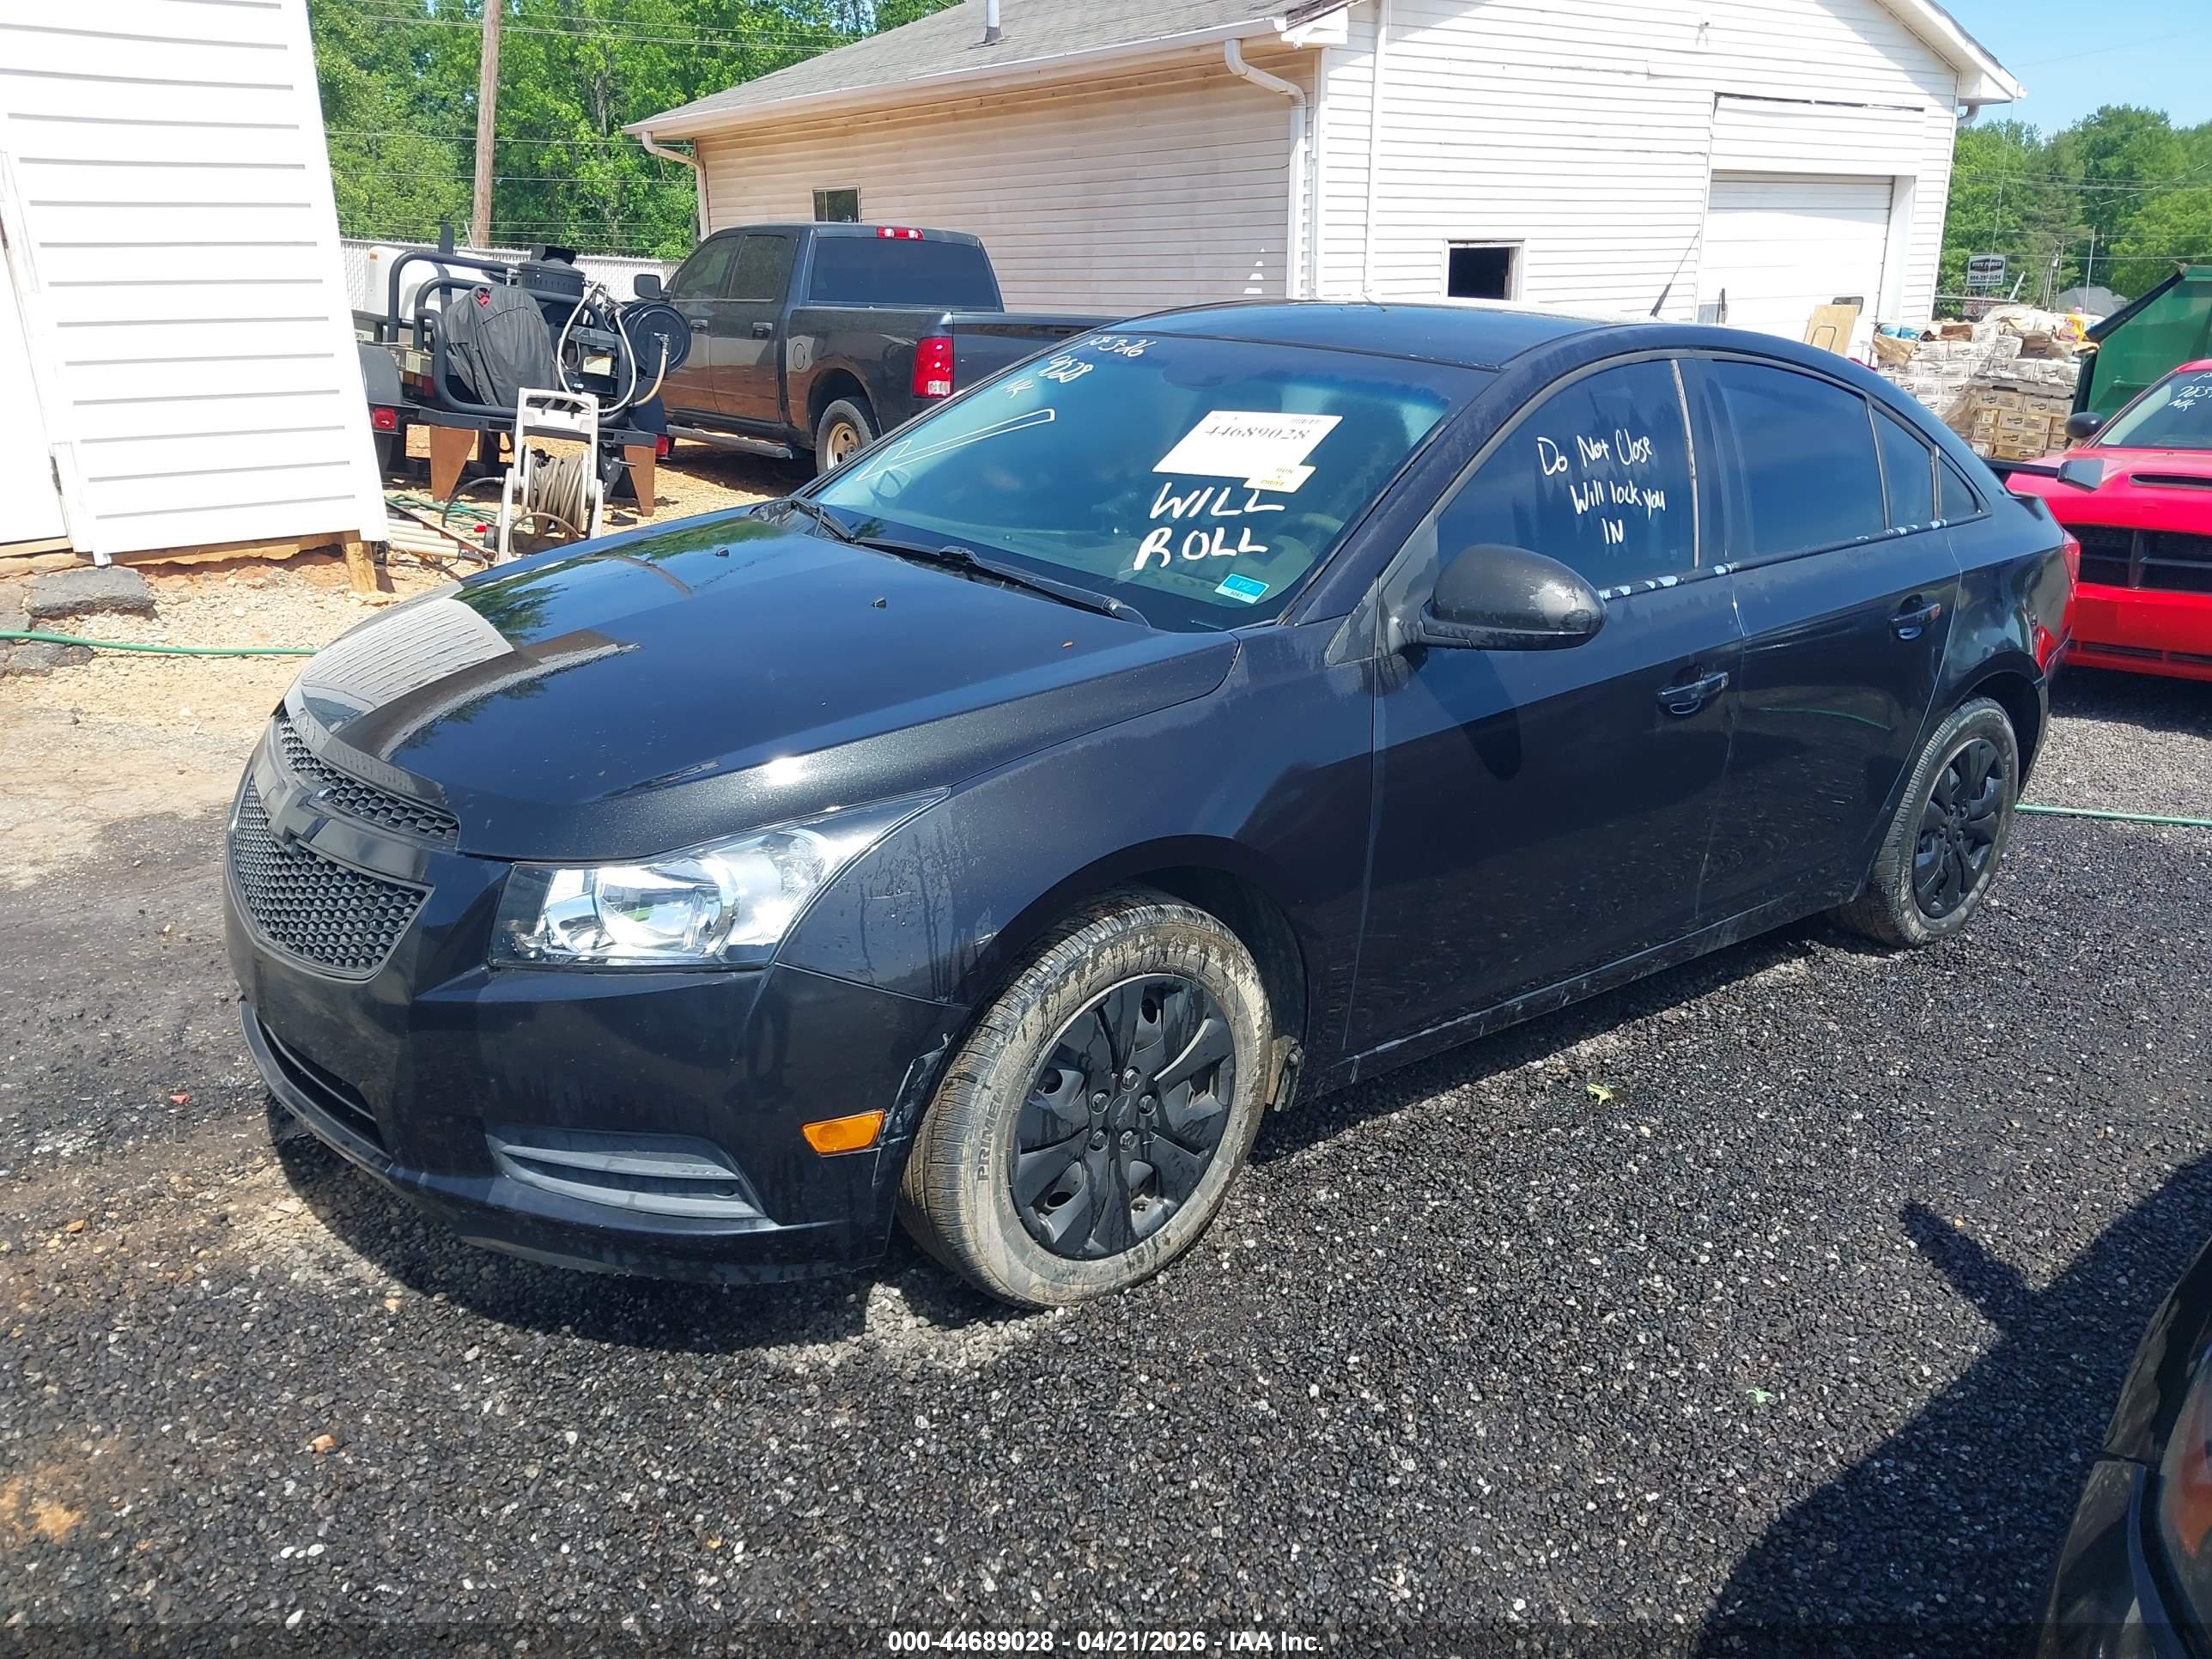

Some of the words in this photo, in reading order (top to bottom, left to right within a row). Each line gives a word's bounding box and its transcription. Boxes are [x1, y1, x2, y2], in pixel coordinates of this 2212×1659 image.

[1536, 435, 1569, 477] Do
[1576, 434, 1611, 469] Not
[1149, 481, 1286, 520] WILL
[1570, 478, 1606, 515] Will
[1609, 479, 1644, 508] lock
[1642, 487, 1667, 522] you
[1132, 526, 1270, 572] ROLL
[1601, 517, 1625, 545] IN
